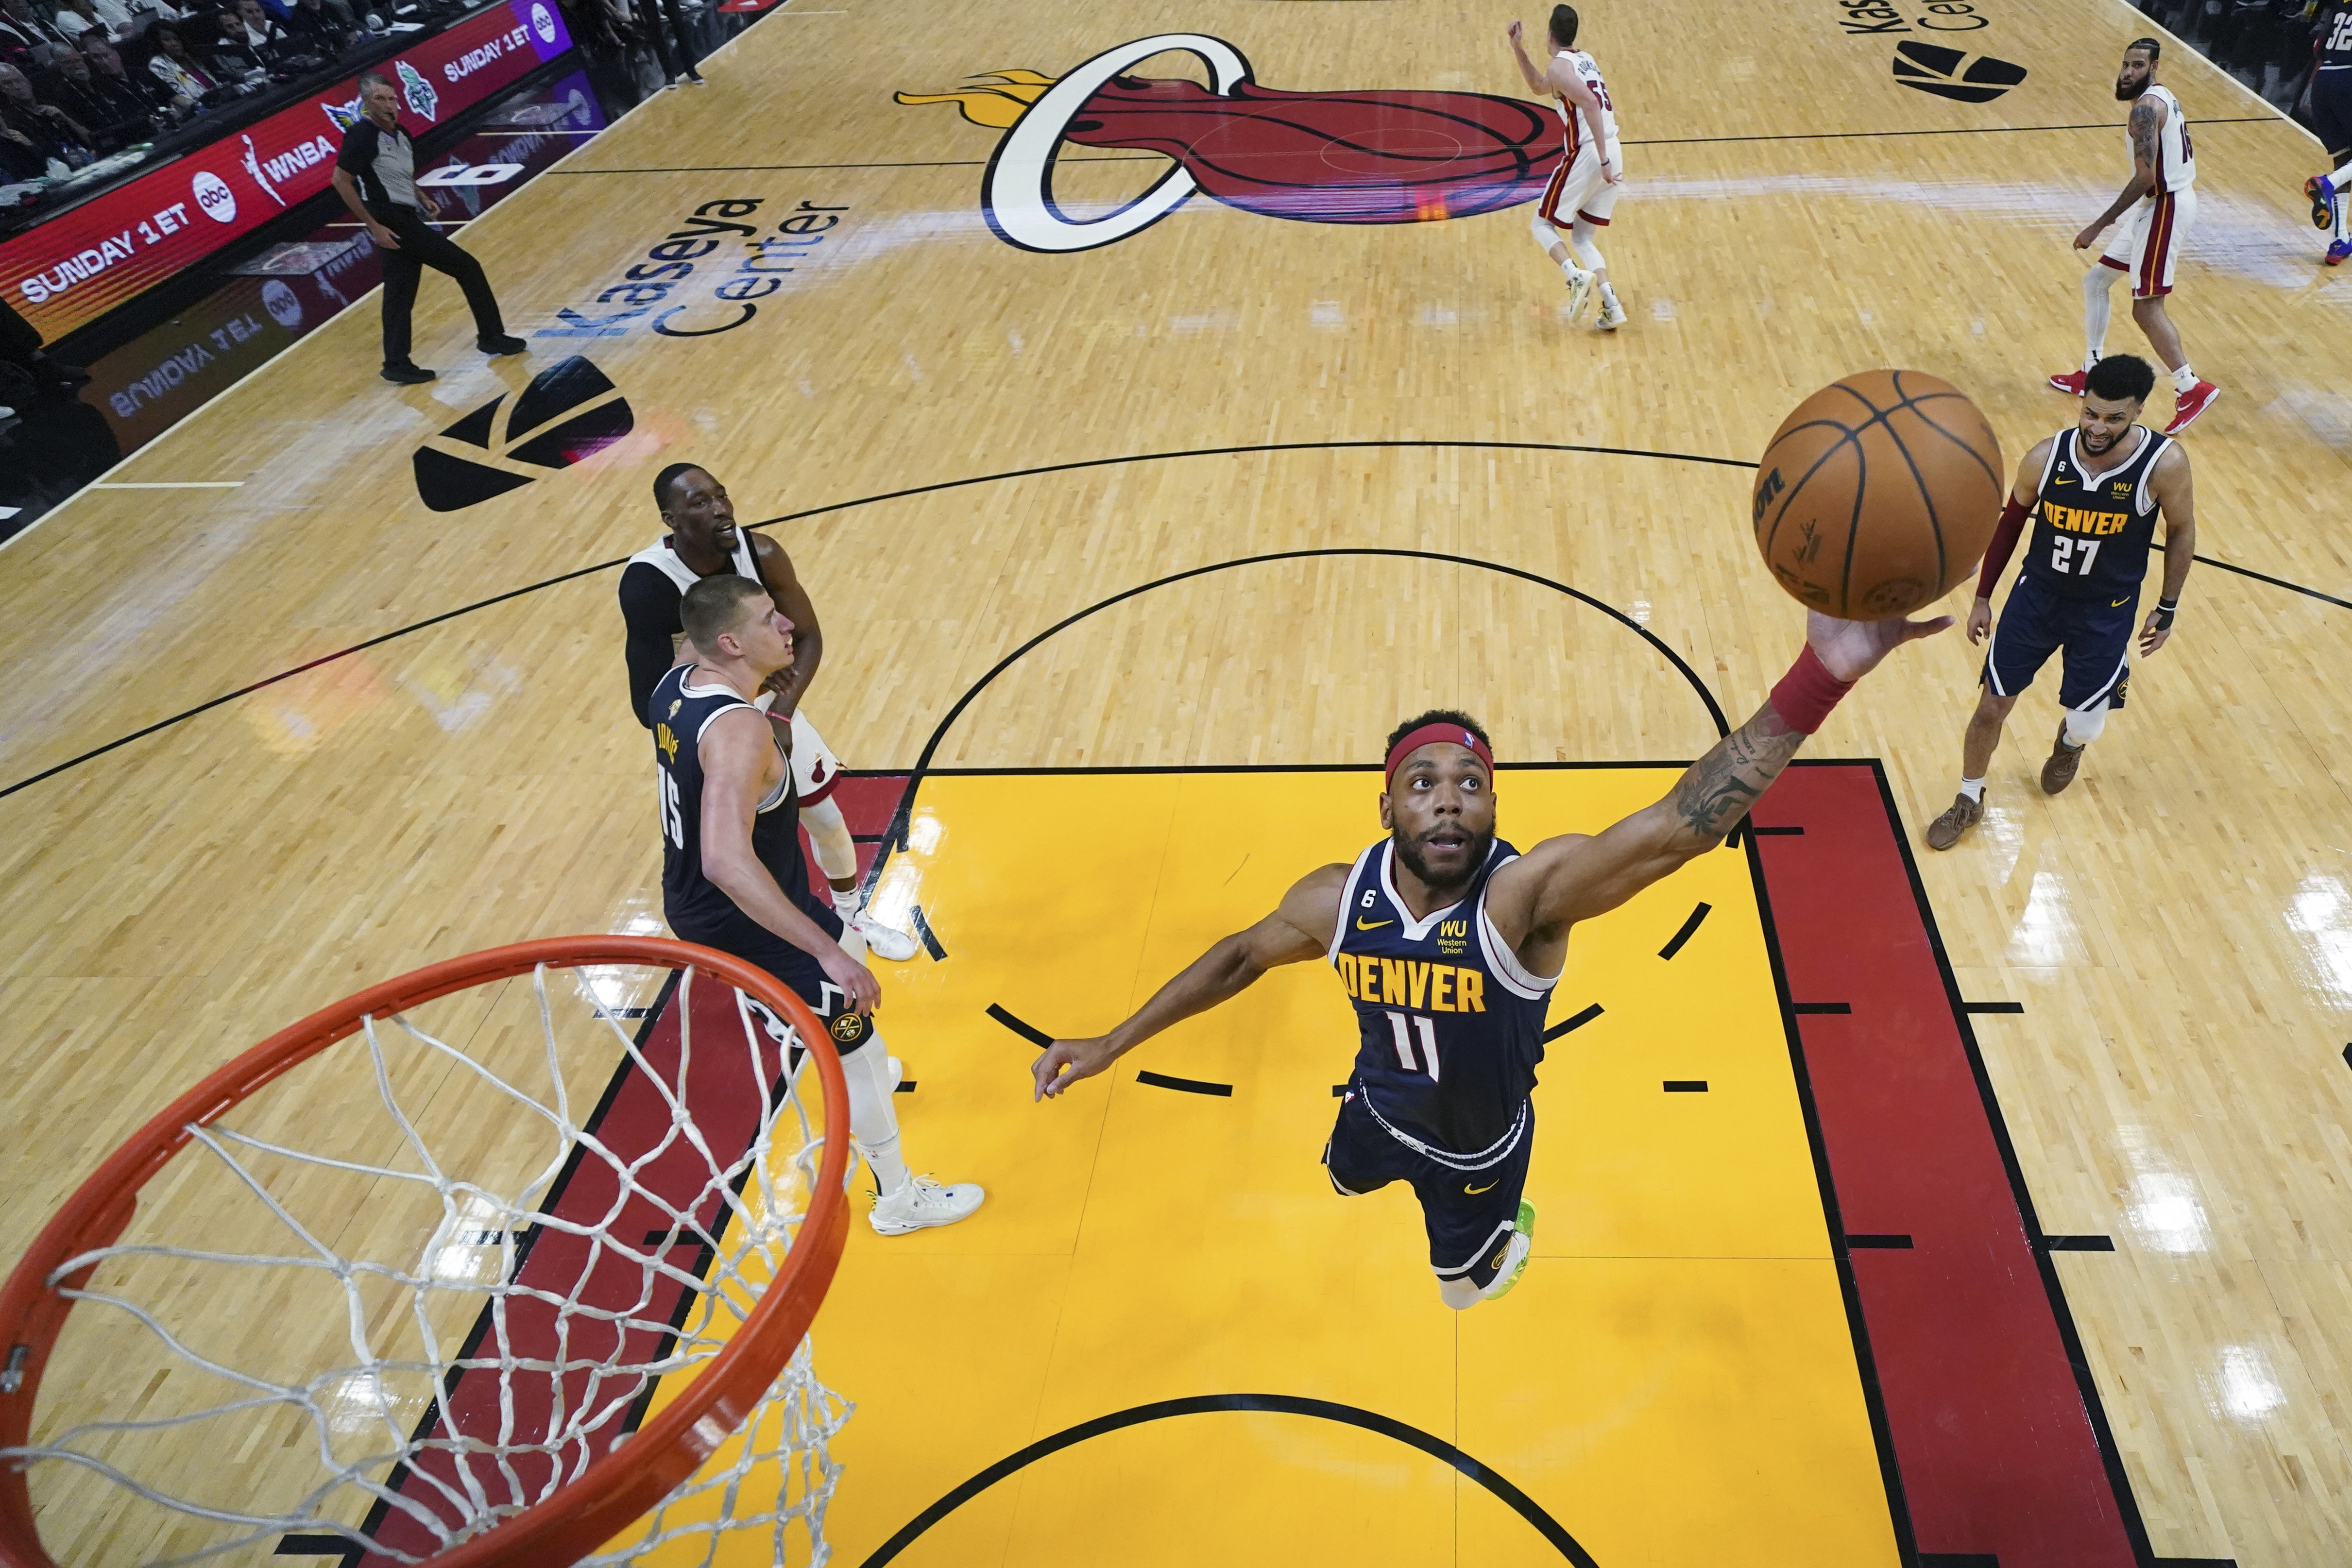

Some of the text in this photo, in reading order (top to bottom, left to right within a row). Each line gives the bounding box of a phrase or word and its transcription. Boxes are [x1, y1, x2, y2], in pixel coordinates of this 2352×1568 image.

[1917, 0, 1989, 31] Ce
[443, 38, 502, 83] SUNDAY
[262, 135, 337, 183] WNBA
[199, 186, 229, 208] abc
[20, 230, 136, 304] SUNDAY
[533, 198, 765, 337] Kaseya
[652, 200, 850, 337] Center
[2057, 460, 2066, 472] 6
[2113, 482, 2132, 492] WU
[2044, 500, 2129, 535] DENVER
[2051, 535, 2101, 576] 27
[657, 762, 684, 850] 15
[1361, 889, 1377, 908] 6
[1436, 938, 1467, 947] Western
[1440, 920, 1467, 937] WU
[1441, 946, 1463, 954] Union
[1339, 952, 1486, 1013] DENVER
[1385, 1010, 1440, 1084] 11
